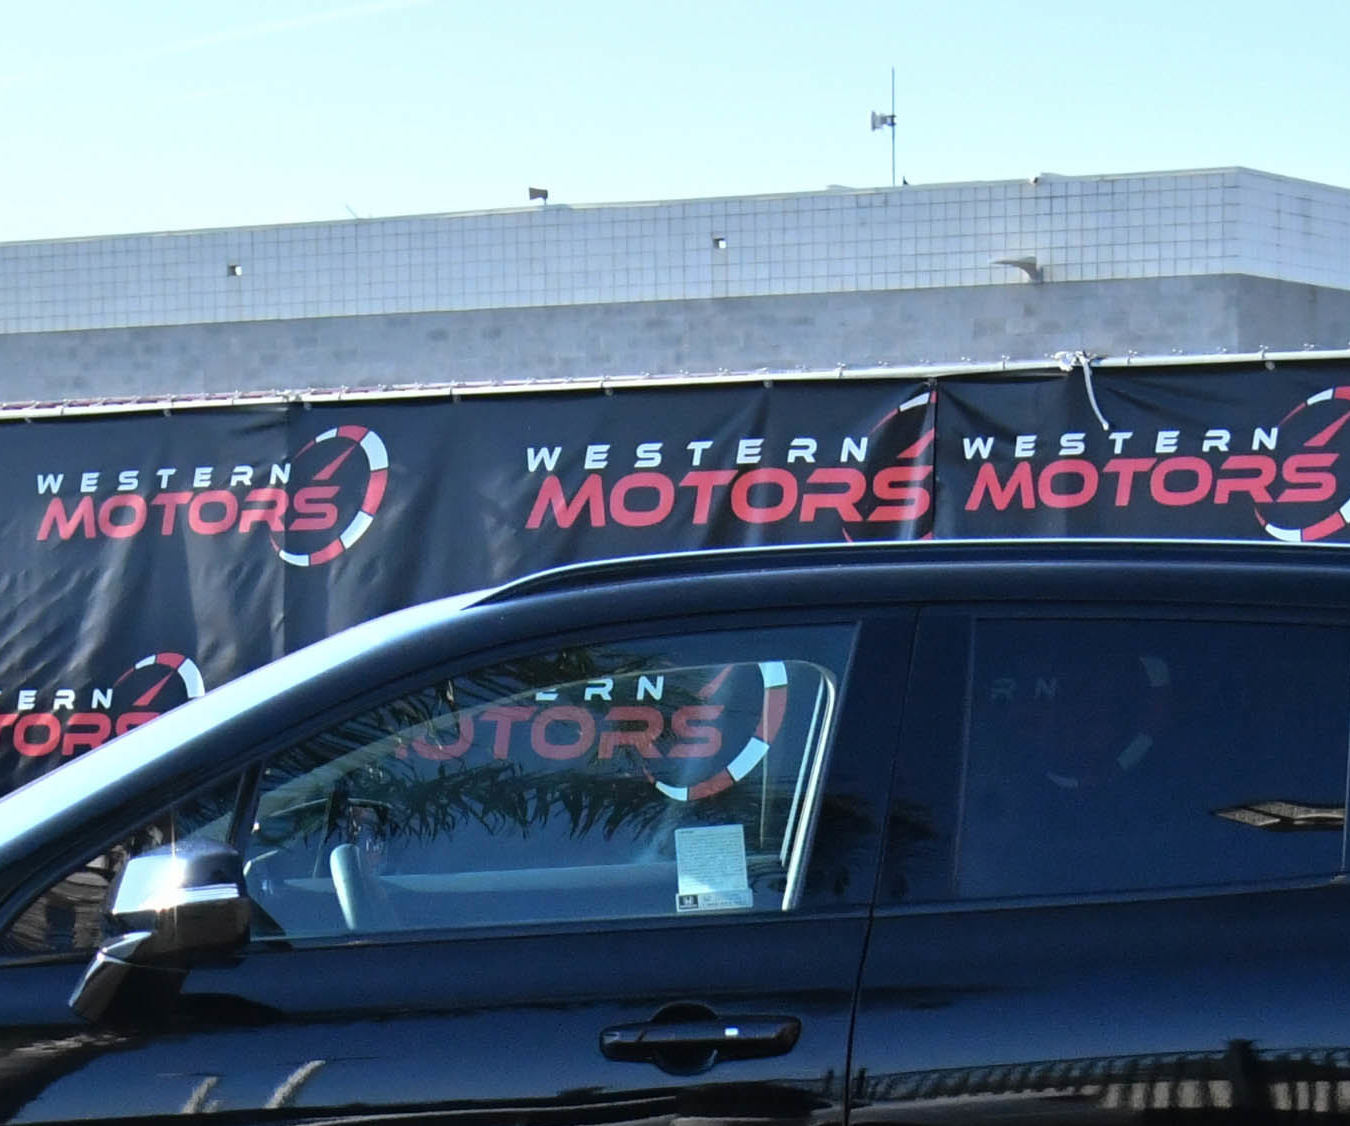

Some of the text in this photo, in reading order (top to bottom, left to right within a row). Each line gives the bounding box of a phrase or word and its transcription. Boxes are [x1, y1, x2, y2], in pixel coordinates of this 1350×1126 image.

[528, 437, 868, 472] WESTERN
[963, 427, 1278, 459] WESTERN
[38, 463, 290, 495] WESTERN
[529, 466, 932, 528] MOTORS
[966, 454, 1338, 510] MOTORS
[38, 487, 339, 542] MOTORS
